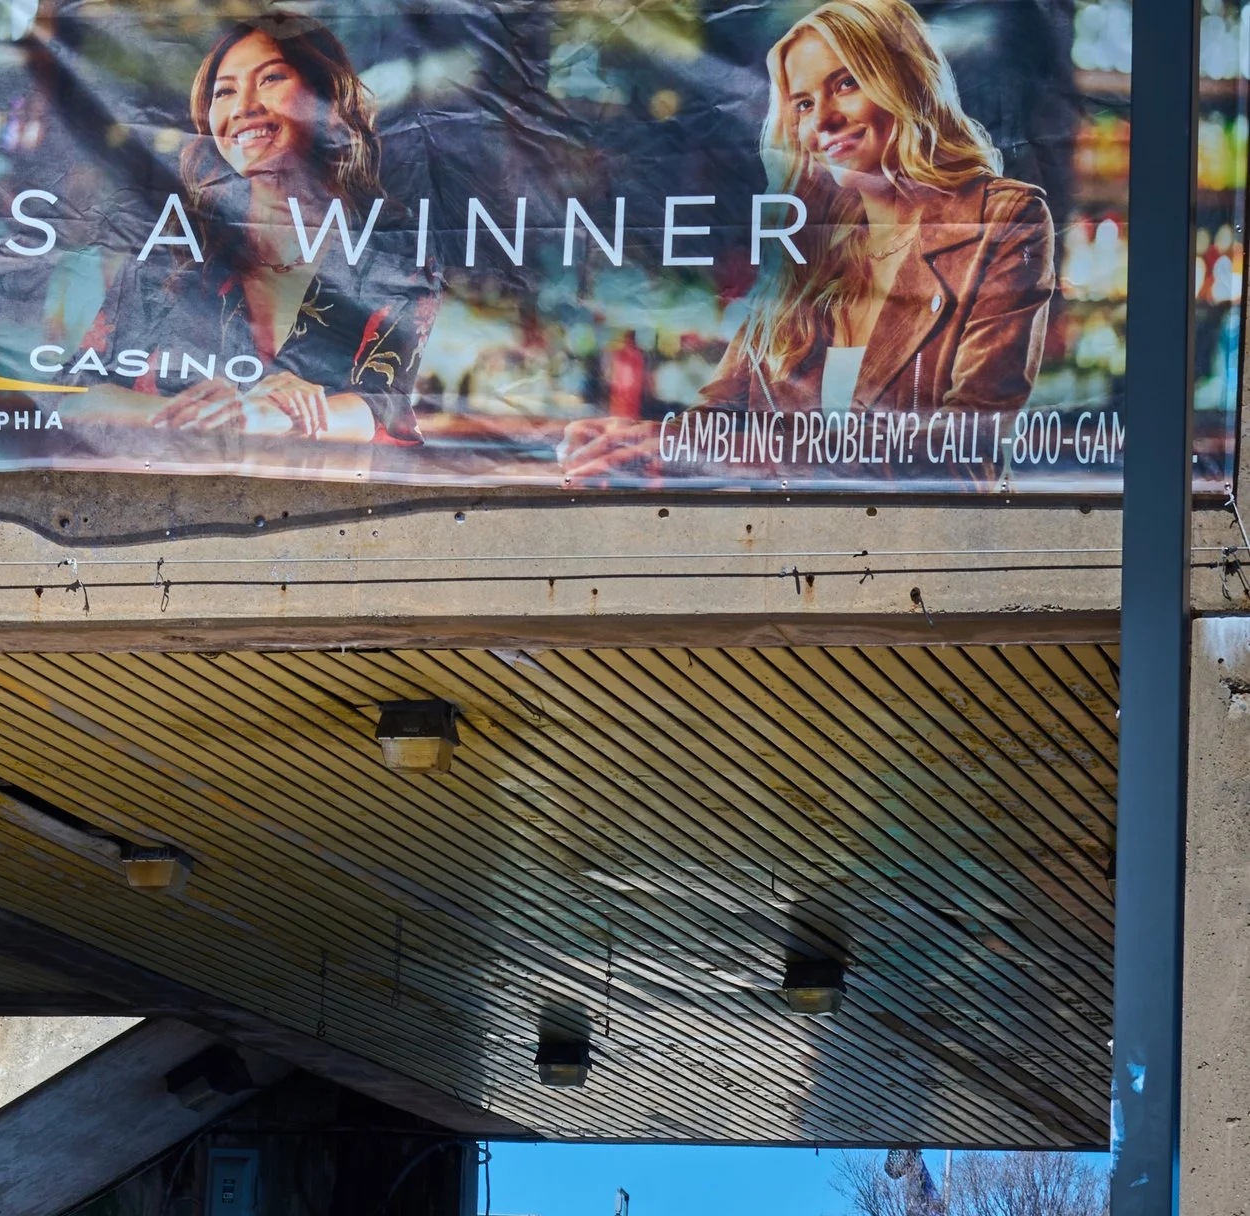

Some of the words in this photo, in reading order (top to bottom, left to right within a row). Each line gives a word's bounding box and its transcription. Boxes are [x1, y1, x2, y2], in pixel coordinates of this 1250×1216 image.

[137, 193, 204, 263] A
[288, 193, 808, 267] WINNER
[29, 344, 264, 383] CASINO
[659, 411, 784, 463] GAMBLING
[791, 411, 919, 463] PROBLEM?
[926, 411, 983, 463] CALL
